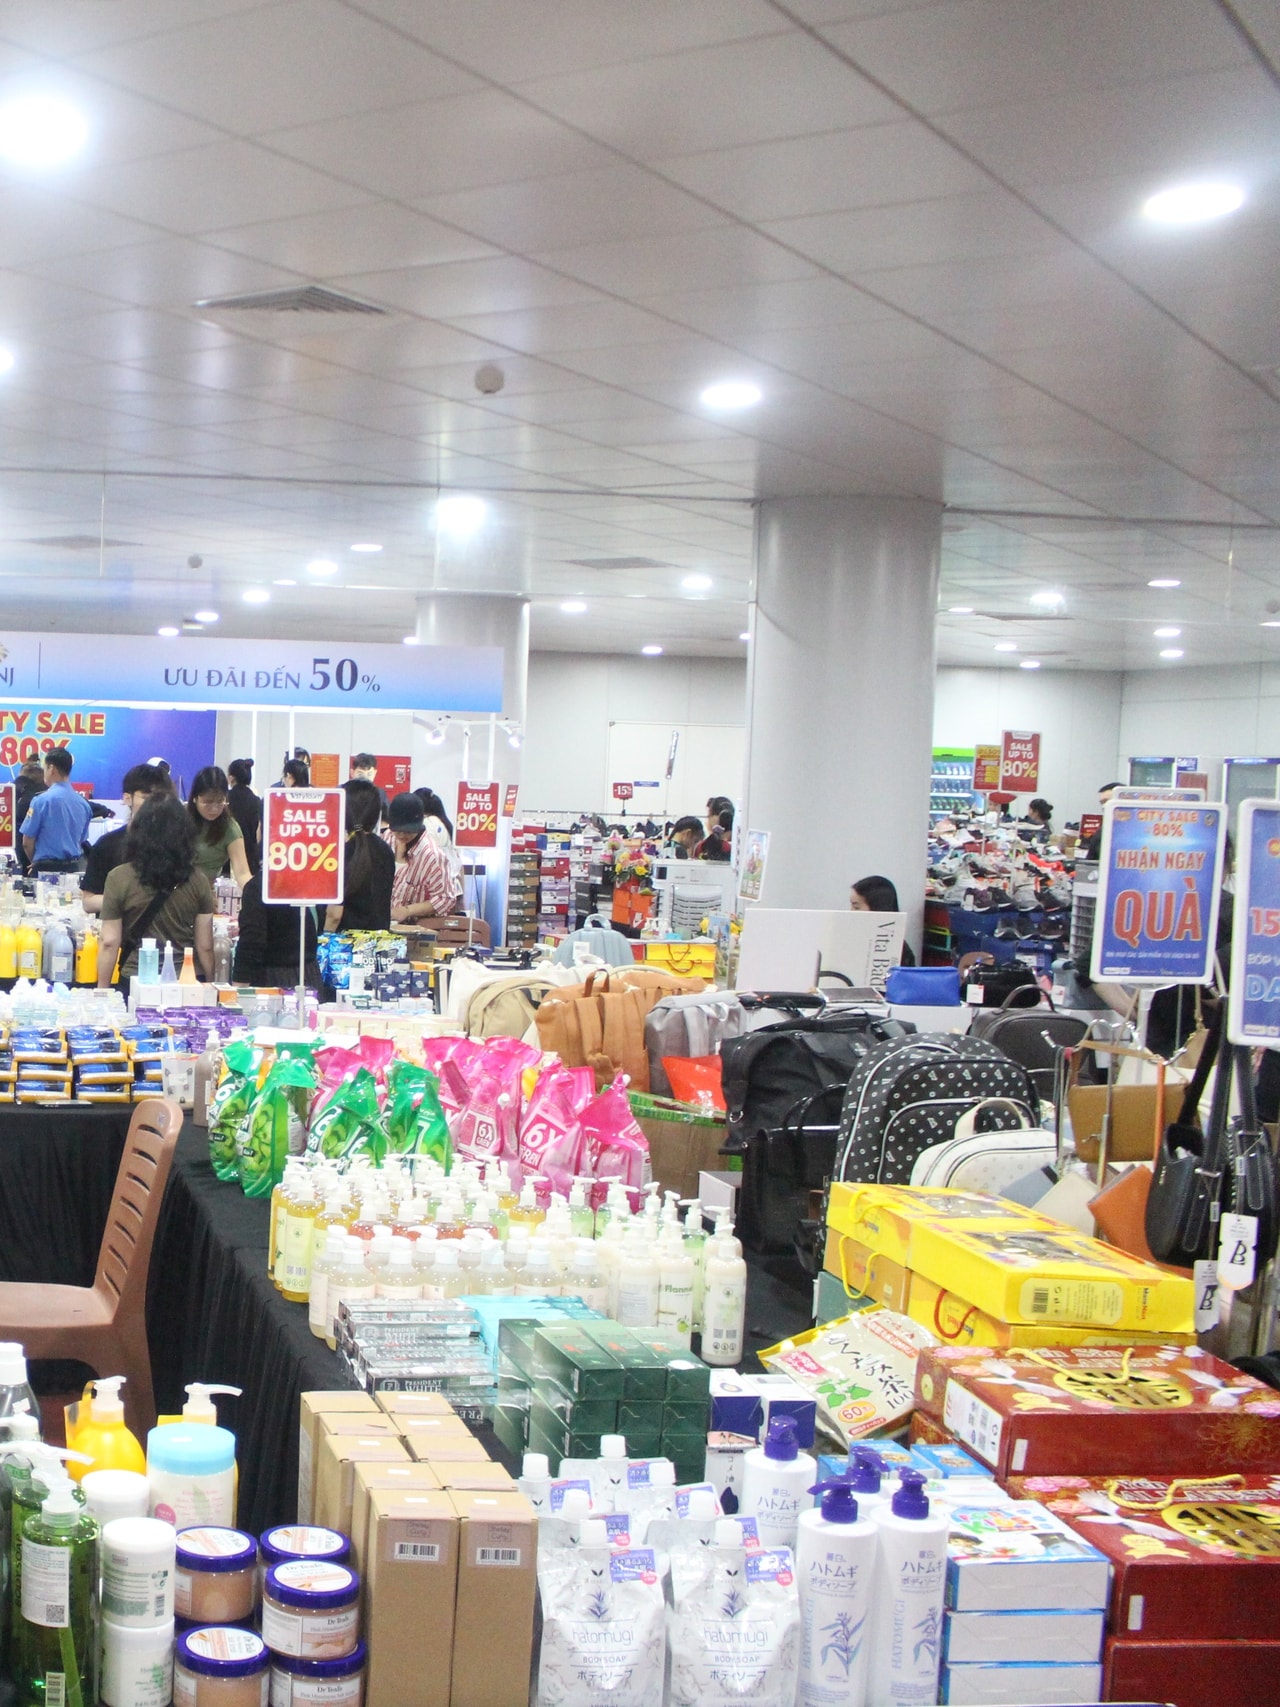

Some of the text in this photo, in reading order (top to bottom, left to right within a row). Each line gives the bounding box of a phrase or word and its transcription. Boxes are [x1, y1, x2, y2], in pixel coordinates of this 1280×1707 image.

[164, 667, 198, 687] ƯU
[206, 667, 246, 689] ĐÃI
[254, 665, 301, 690] ĐẾN
[37, 712, 105, 736] SALE
[1010, 743, 1032, 751] SALE
[1008, 751, 1034, 759] UP TO
[1002, 761, 1037, 778] 80%
[465, 793, 491, 802] SALE
[463, 802, 492, 811] UP TO
[283, 810, 327, 823] SALE
[457, 814, 496, 832] 80%
[1136, 811, 1198, 823] CITY SALE
[279, 824, 330, 838] UP TO
[269, 842, 338, 872] 80%
[1117, 847, 1206, 873] NHẬN NGAY
[1113, 876, 1203, 948] QUÀ
[874, 921, 896, 952] Vita
[477, 1121, 493, 1140] 6X
[757, 1496, 800, 1510] ハトムギ
[809, 1561, 859, 1577] ハトムギ
[901, 1560, 943, 1575] ハトムギ
[809, 1577, 856, 1590] ボディソープ
[572, 1627, 634, 1646] hatomugi
[704, 1627, 768, 1646] hatomugi
[892, 1599, 906, 1670] HATOMUGI
[583, 1655, 626, 1663] BODY SOAP
[577, 1669, 633, 1682] ボディソープ
[710, 1669, 766, 1682] ボディソープ
